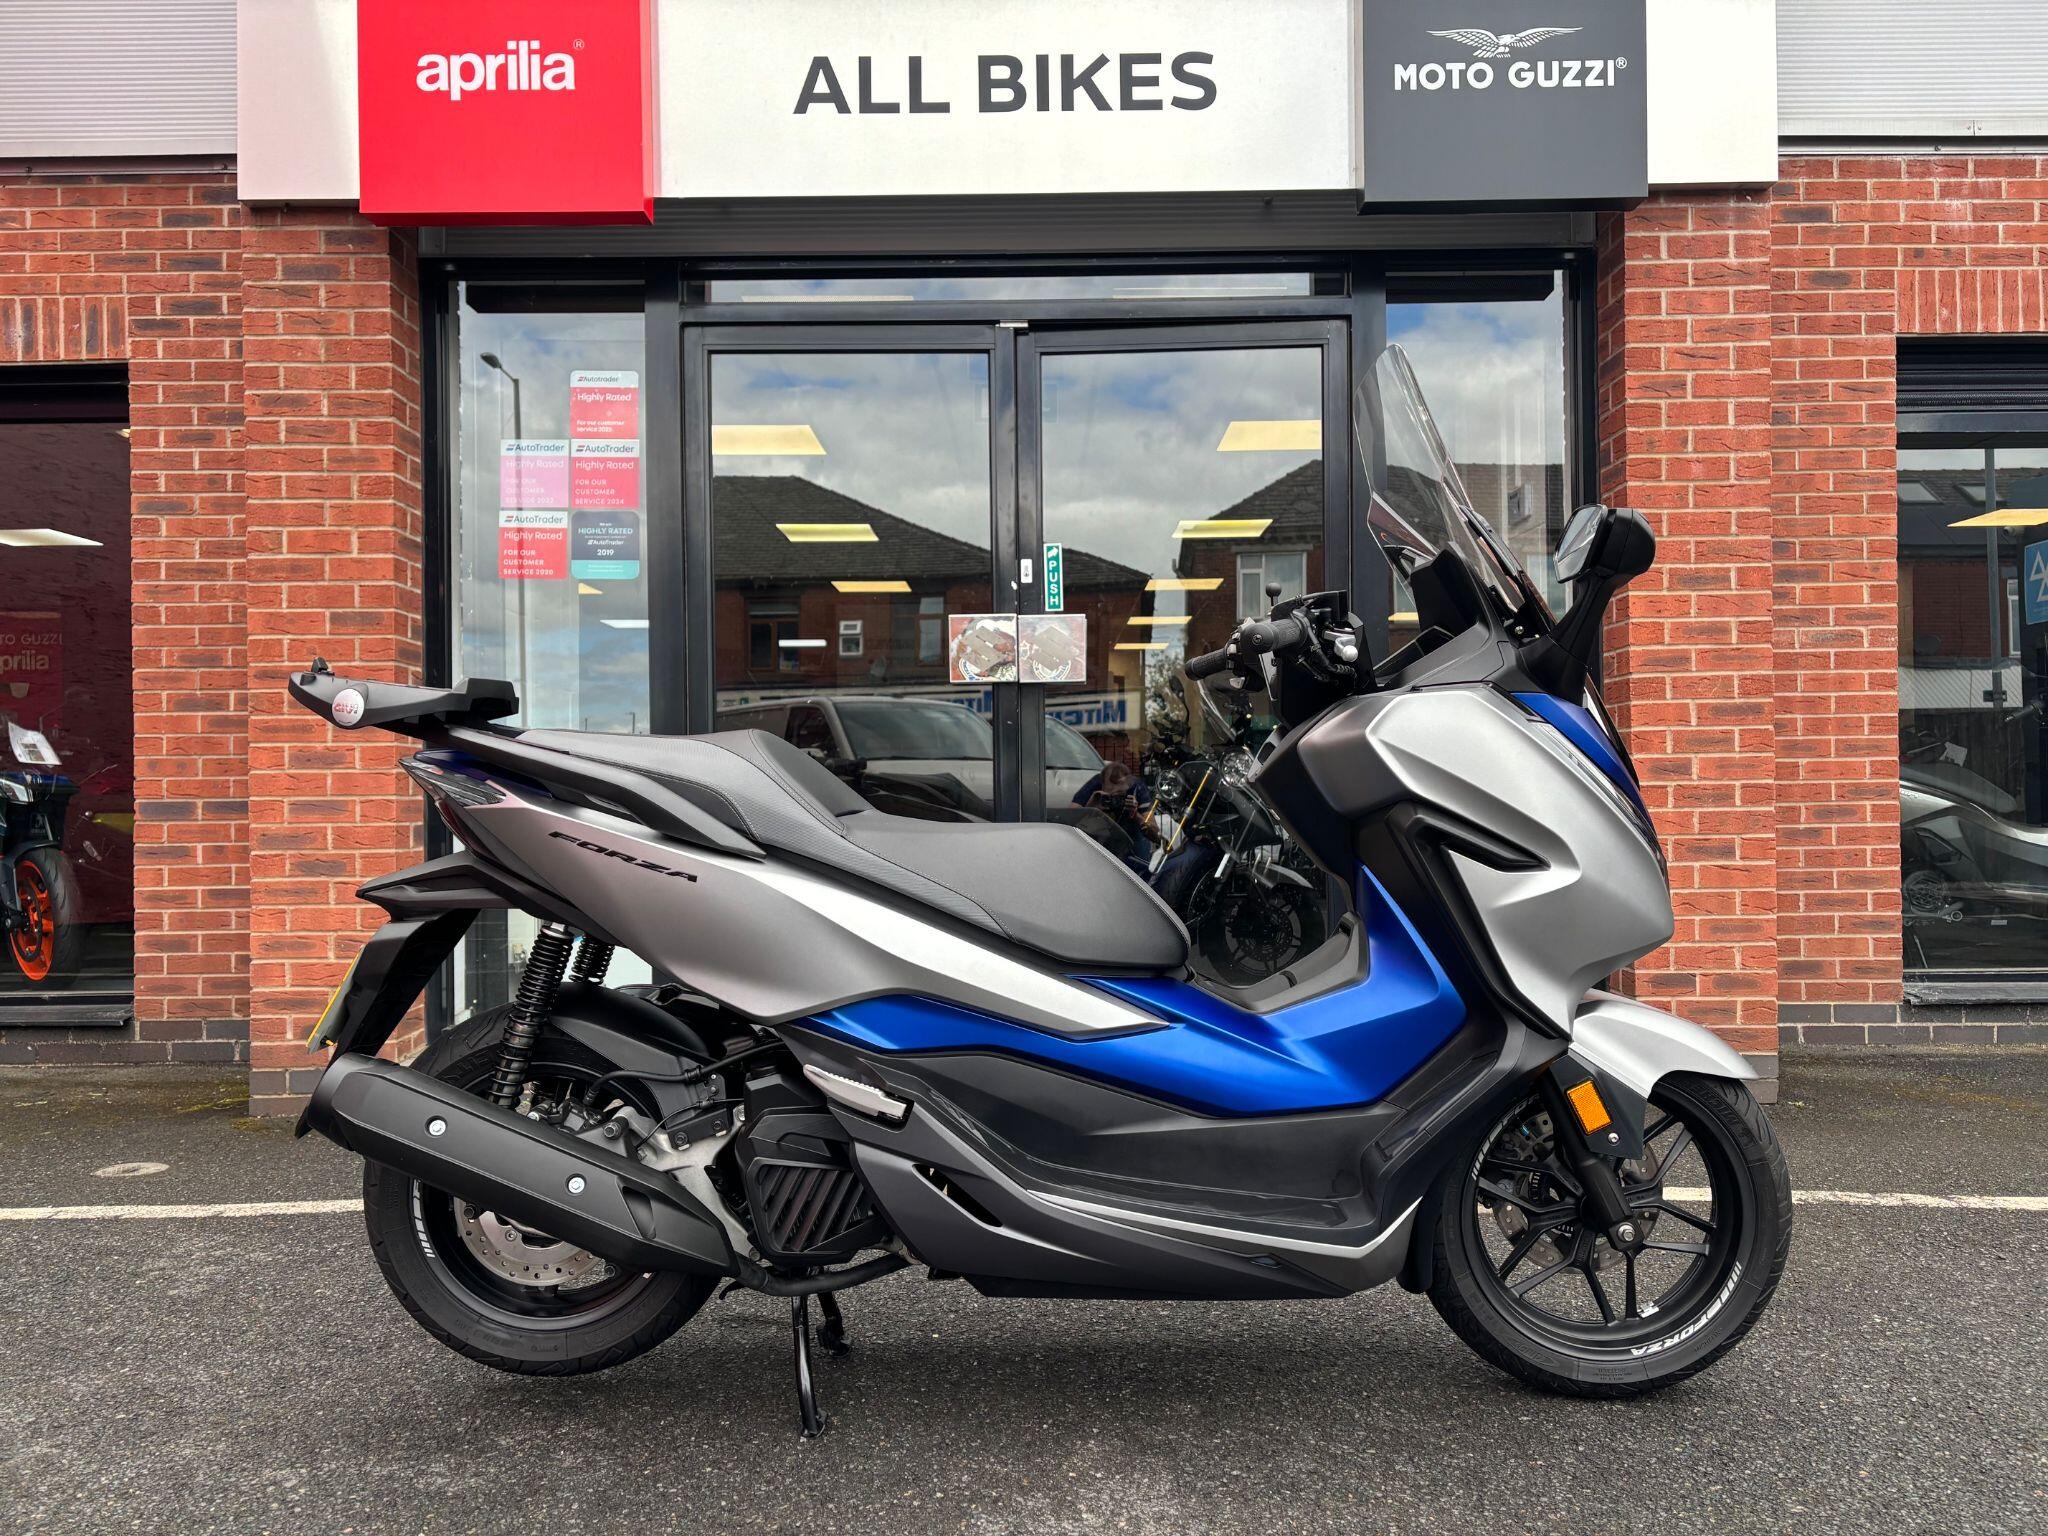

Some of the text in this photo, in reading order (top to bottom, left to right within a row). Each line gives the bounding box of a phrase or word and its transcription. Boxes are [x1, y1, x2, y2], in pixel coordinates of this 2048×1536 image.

[416, 40, 576, 101] aprilia
[1394, 59, 1616, 90] MOTO GUZZI
[793, 51, 1217, 114] ALL BIKES
[577, 392, 632, 403] Highly Rated
[514, 443, 565, 452] AutoTrader
[584, 444, 635, 453] AutoTrader
[537, 460, 564, 469] Rated
[575, 460, 634, 471] Highly Rated
[513, 515, 564, 524] AutoTrader
[504, 531, 563, 541] Highly Rated
[577, 527, 634, 535] HIGHLY RATED
[1048, 560, 1059, 606] PUSH
[21, 633, 63, 645] GUZZI
[548, 831, 698, 883] FORZA
[1630, 1311, 1709, 1356] FORZA
